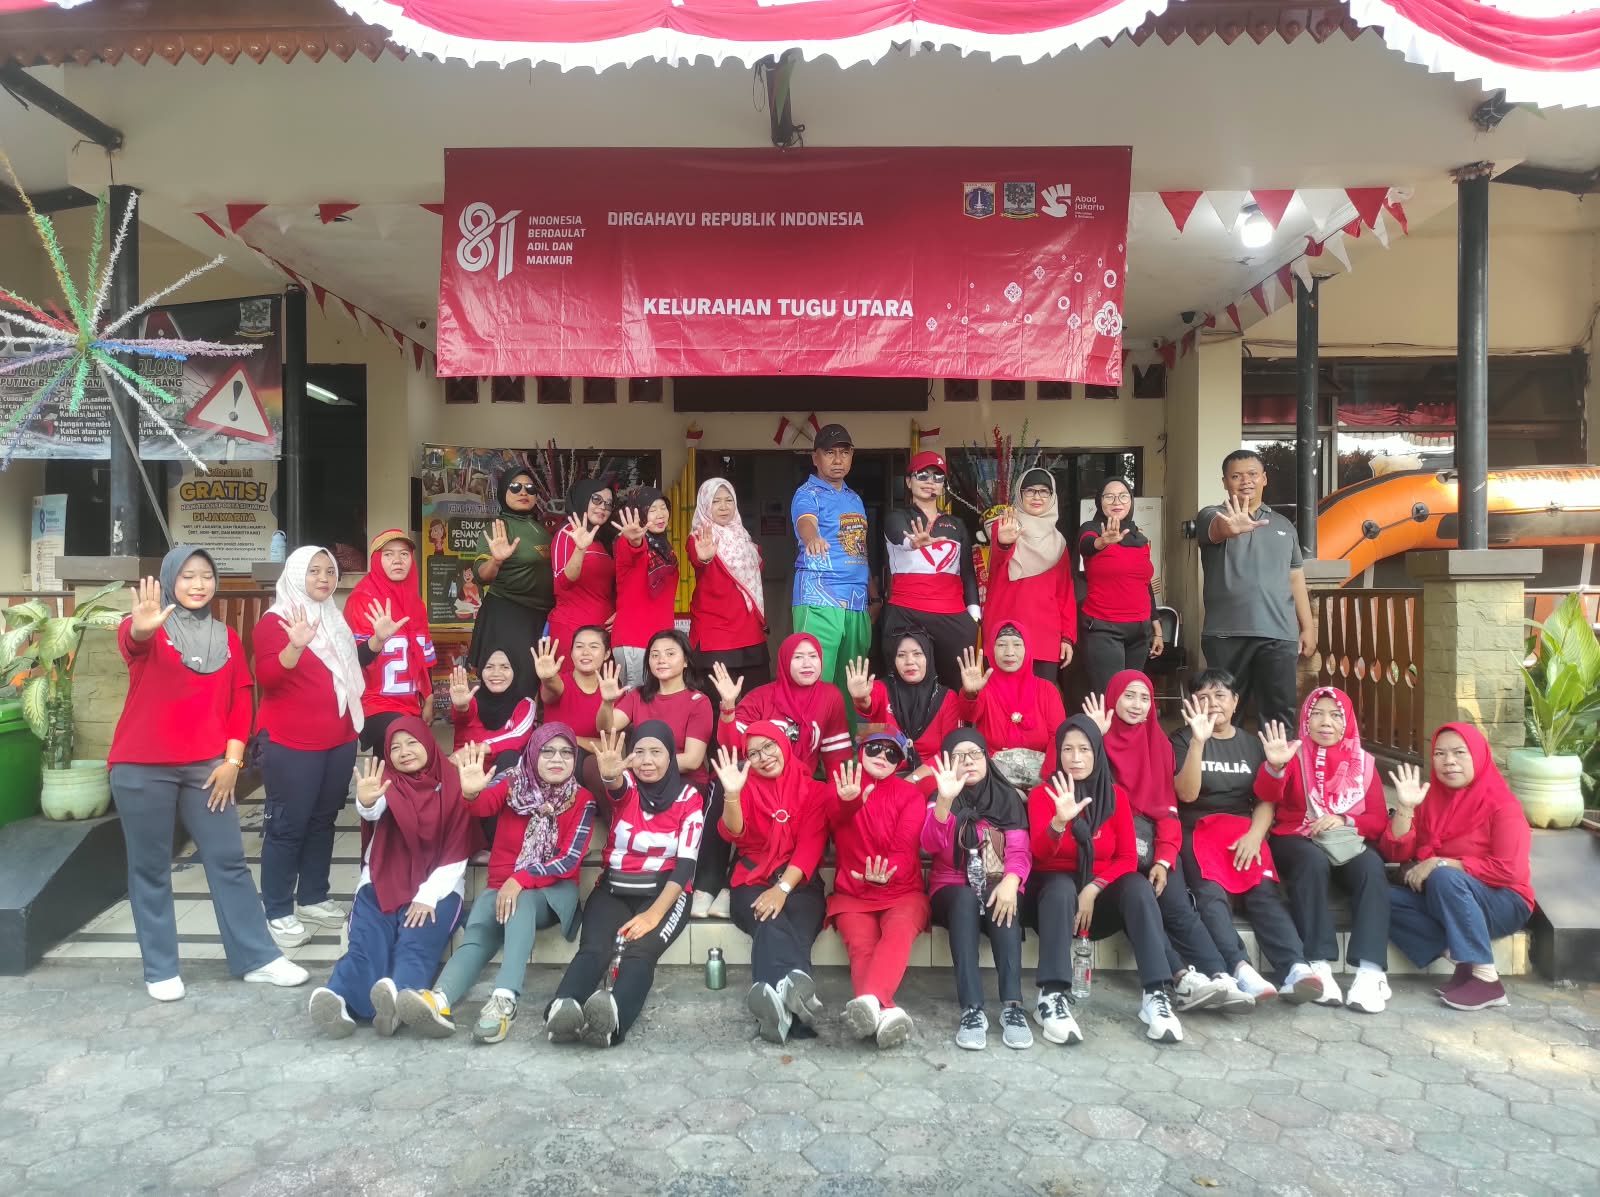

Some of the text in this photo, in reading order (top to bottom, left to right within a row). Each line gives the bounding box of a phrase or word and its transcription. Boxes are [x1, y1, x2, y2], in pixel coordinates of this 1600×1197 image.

[1074, 195, 1097, 203] Abad
[1074, 203, 1105, 211] Jakarta
[529, 215, 583, 225] INDONESIA
[607, 211, 865, 227] DIRGAHAYU REPUBLIK INDONESIA
[528, 228, 587, 238] BERDAULAT
[456, 201, 524, 282] 81
[527, 242, 573, 251] ADIL DAN
[526, 255, 573, 265] MAKMUR
[643, 297, 914, 317] KELURAHAN TUGU UTARA
[180, 480, 268, 503] GRATIS!
[193, 512, 257, 522] DI JAKARTA
[609, 820, 679, 871] 17
